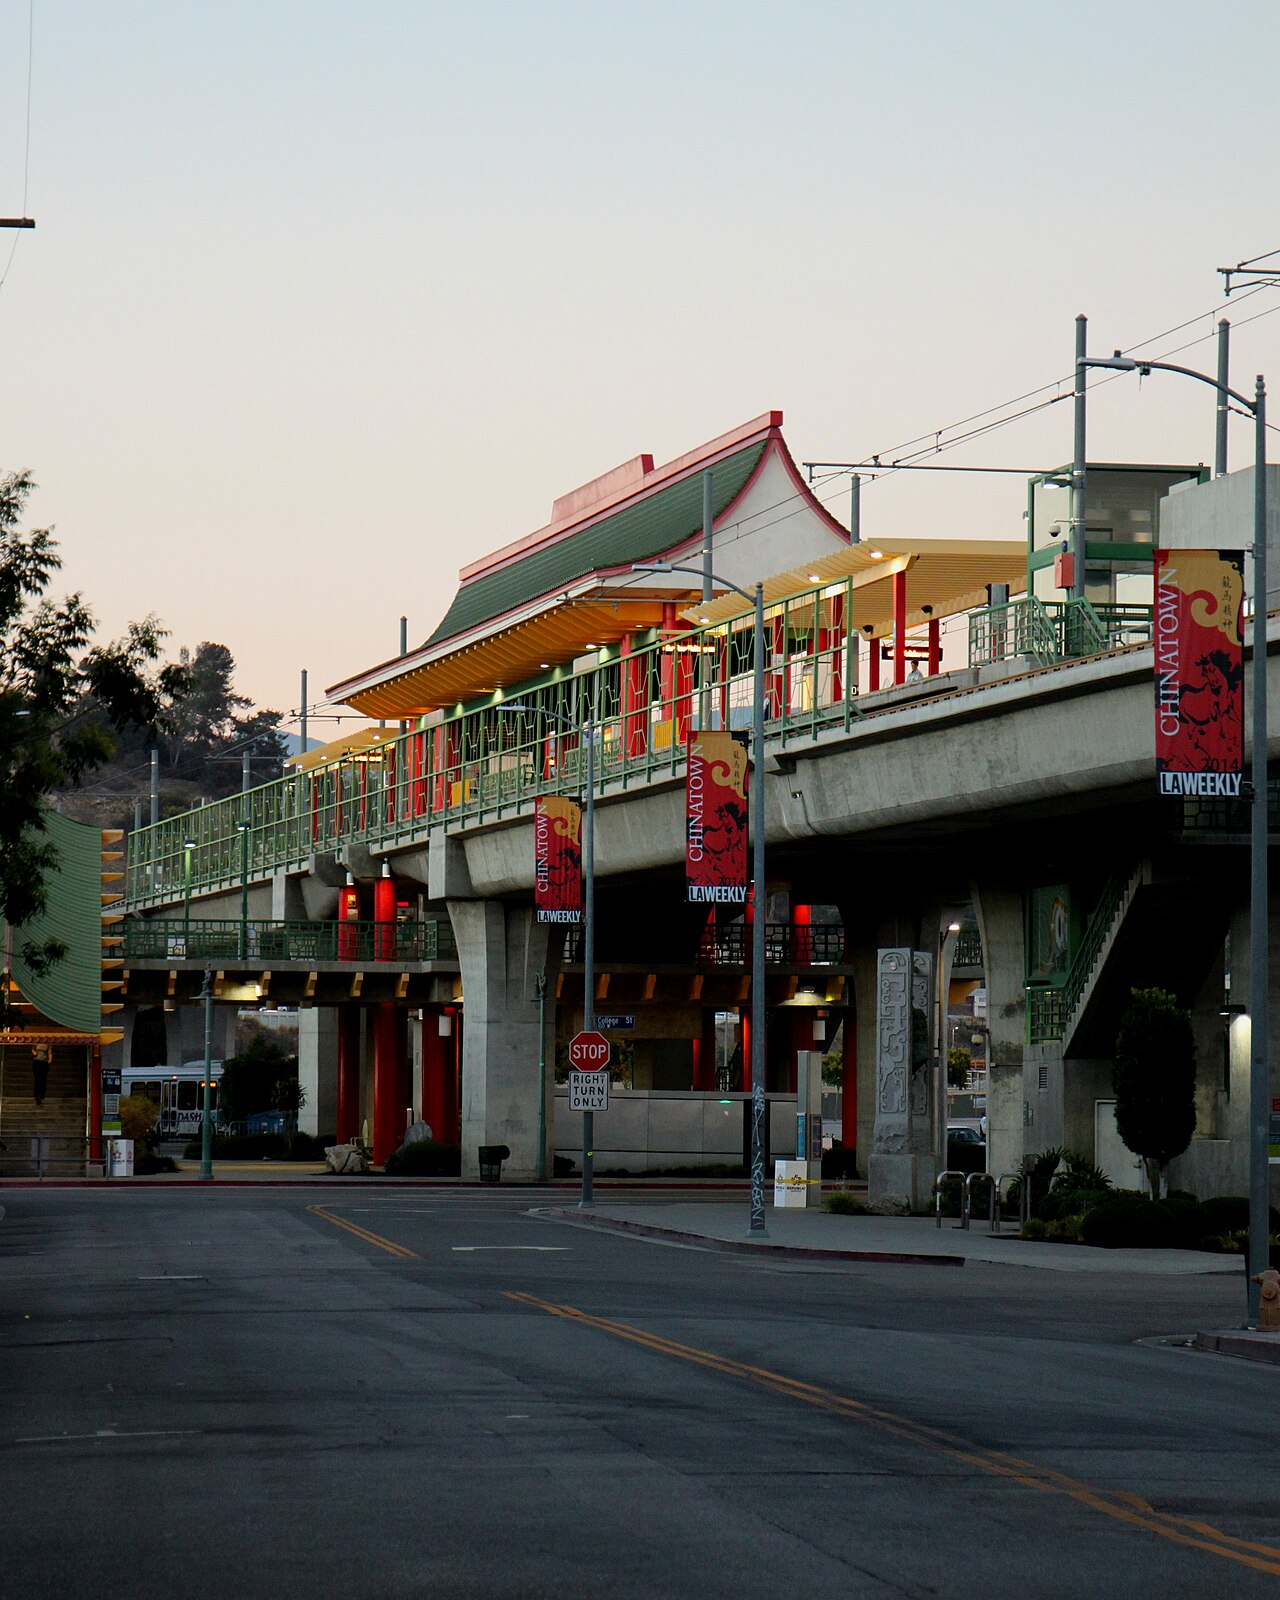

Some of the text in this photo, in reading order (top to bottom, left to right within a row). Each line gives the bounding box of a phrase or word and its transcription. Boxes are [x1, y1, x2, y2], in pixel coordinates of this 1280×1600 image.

[1158, 567, 1181, 737] CHINATOWN
[1201, 758, 1239, 772] 2014
[689, 743, 704, 862] CHINATOWN
[537, 804, 549, 893] CHINATOWN
[718, 876, 745, 886] 2014
[572, 1044, 607, 1060] STOP
[573, 1074, 606, 1084] RIGHT
[574, 1086, 604, 1095] TURN
[574, 1097, 604, 1107] ONLY
[178, 1112, 202, 1121] DASH
